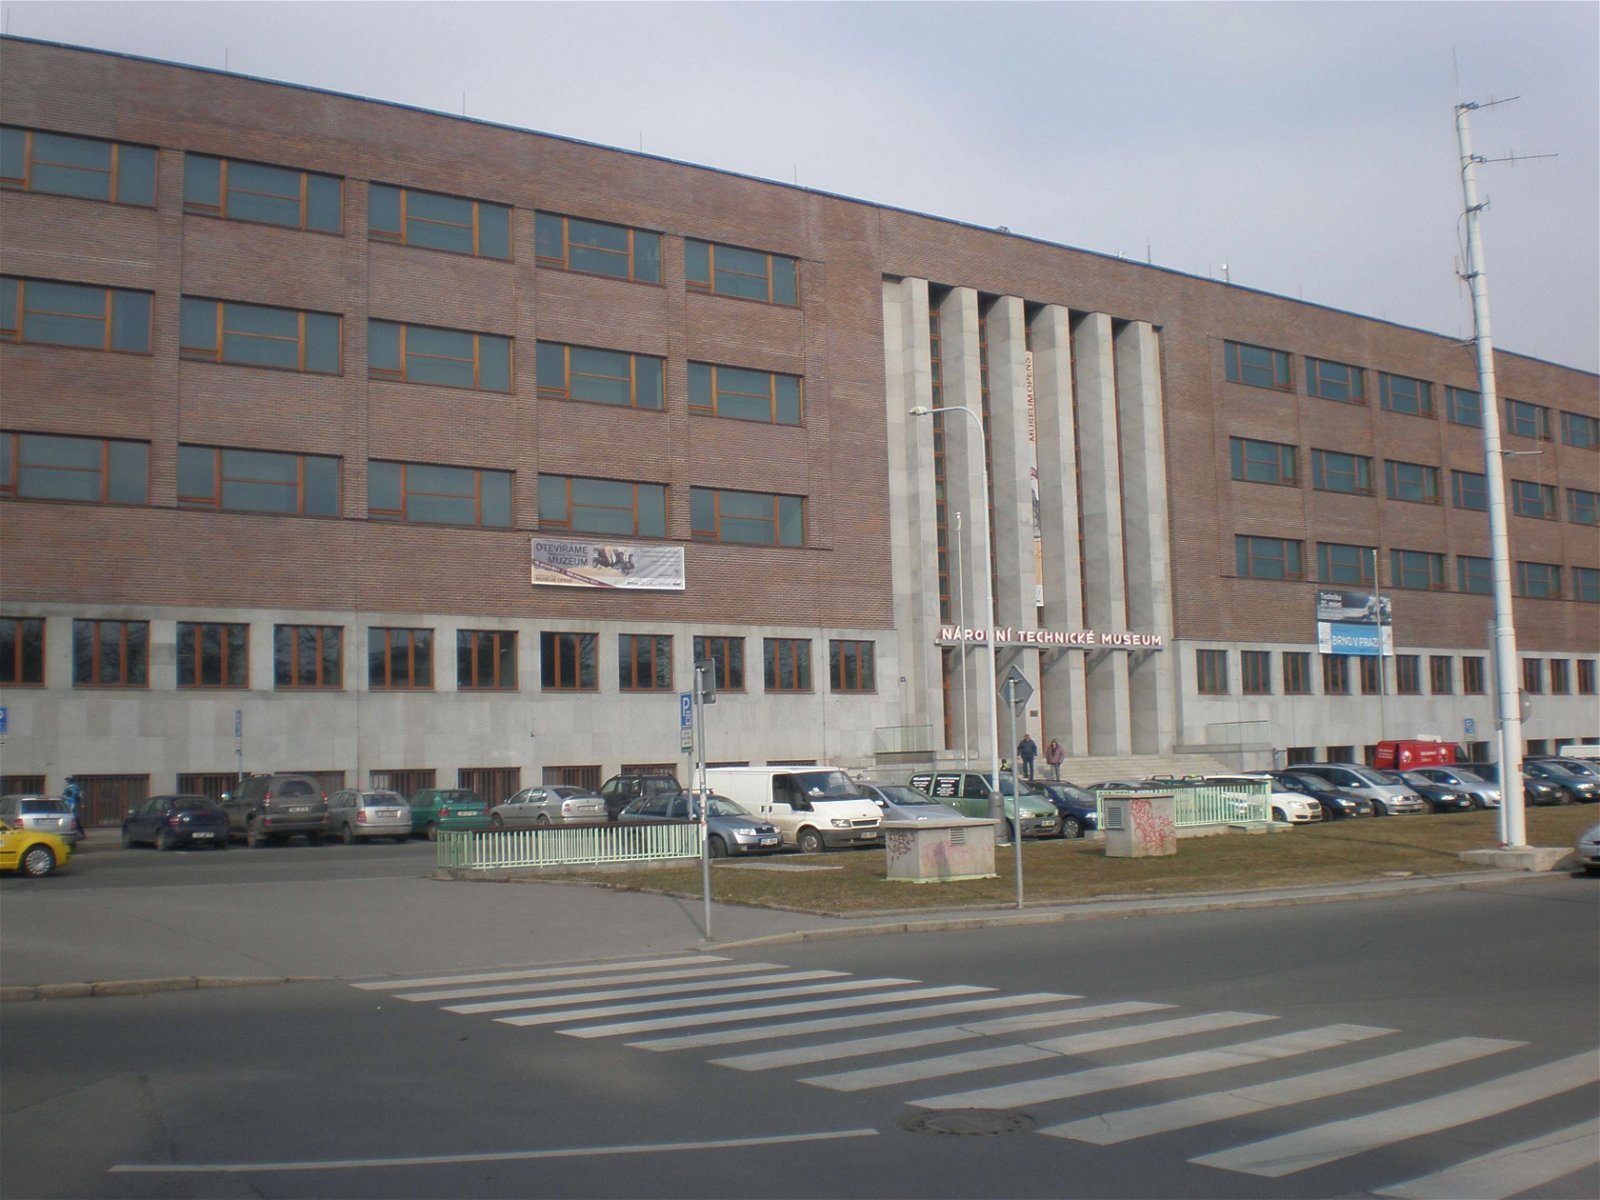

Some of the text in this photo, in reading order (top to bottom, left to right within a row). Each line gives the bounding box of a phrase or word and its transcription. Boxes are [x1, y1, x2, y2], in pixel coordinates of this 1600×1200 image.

[548, 556, 588, 566] MUZEUM
[941, 625, 1162, 646] NÁRONÍ TECHNICKÉ MUSEUM
[682, 696, 690, 718] P
